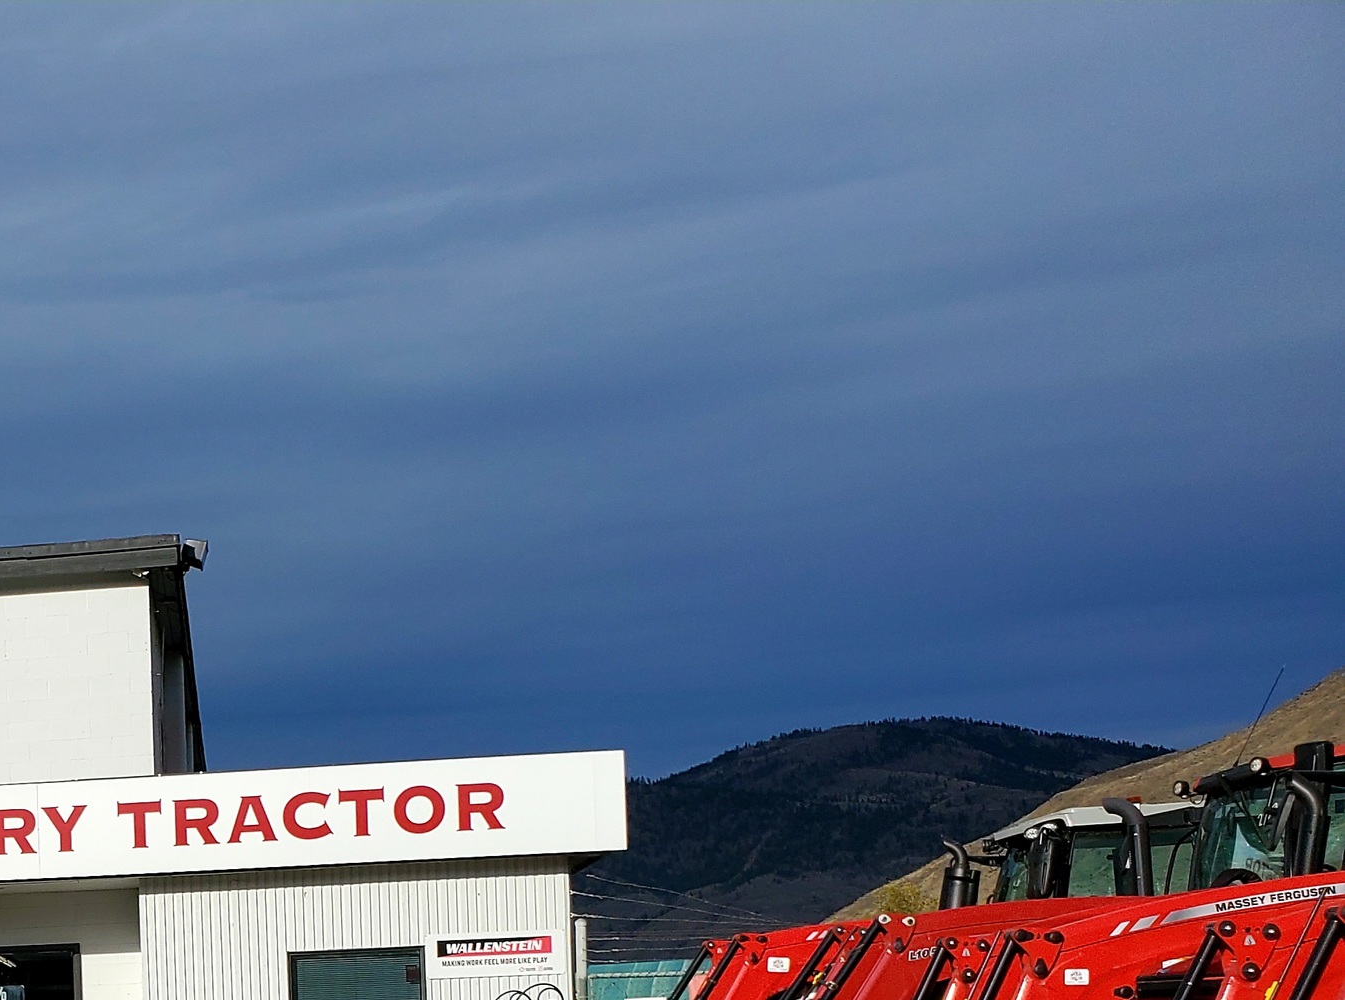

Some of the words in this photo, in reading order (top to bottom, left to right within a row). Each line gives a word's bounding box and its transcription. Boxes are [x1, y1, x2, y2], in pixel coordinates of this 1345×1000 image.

[116, 782, 506, 849] TRACTOR
[1214, 896, 1266, 912] MASSEY
[1270, 886, 1336, 903] FERGUSON
[446, 940, 542, 954] WALLENSTEIN
